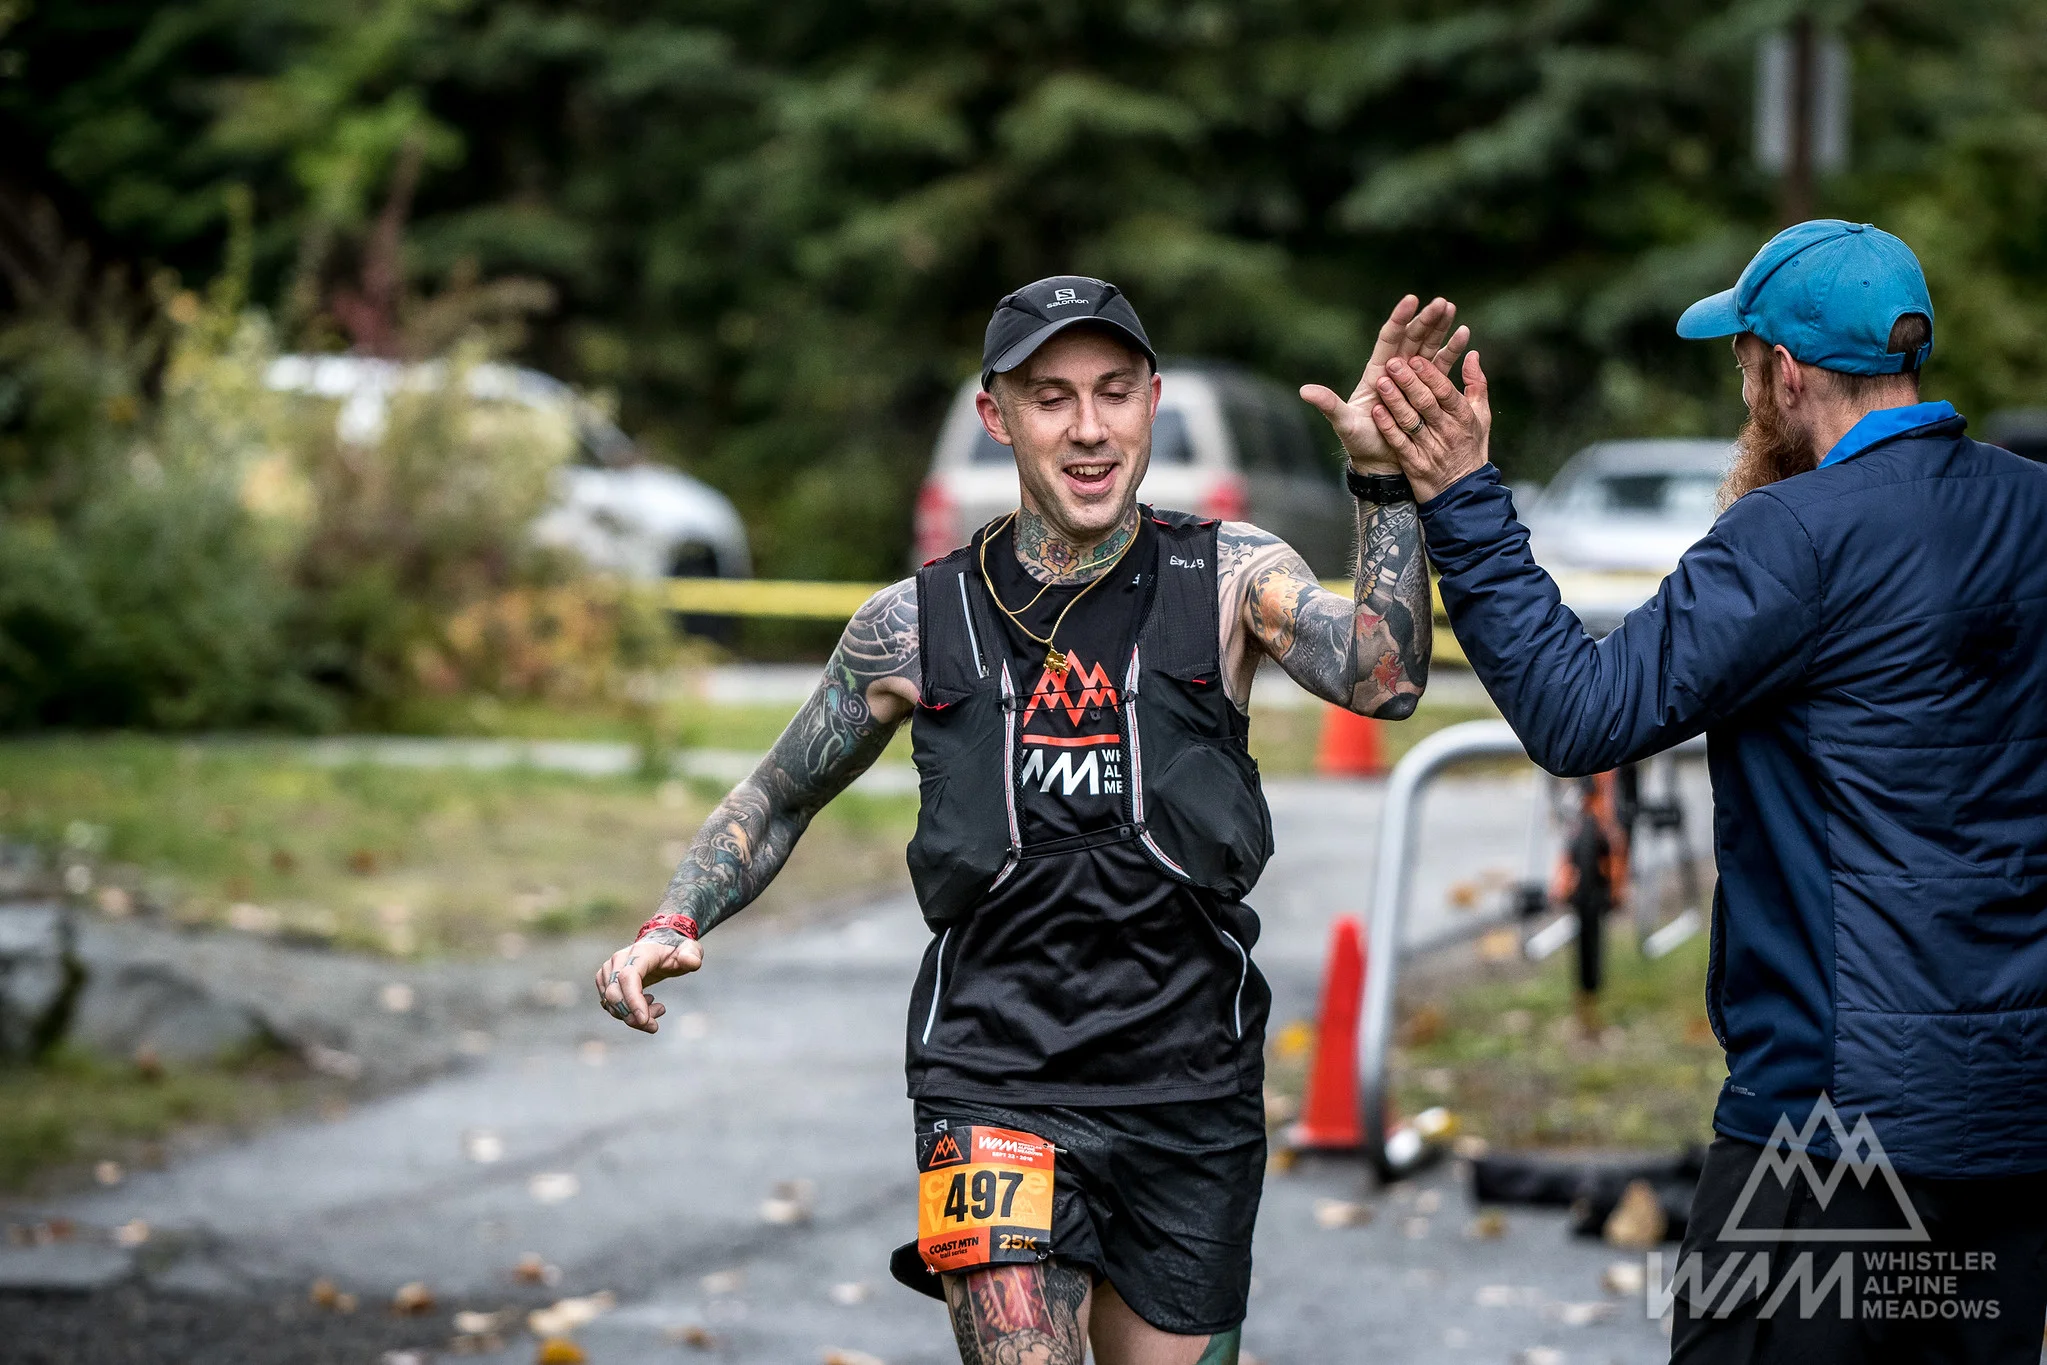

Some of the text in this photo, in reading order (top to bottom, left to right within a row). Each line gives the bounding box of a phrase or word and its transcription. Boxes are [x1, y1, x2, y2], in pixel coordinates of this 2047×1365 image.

[944, 1170, 1024, 1222] 497
[929, 1236, 979, 1254] COAST MTN
[999, 1234, 1037, 1250] 25K
[951, 1248, 968, 1257] series
